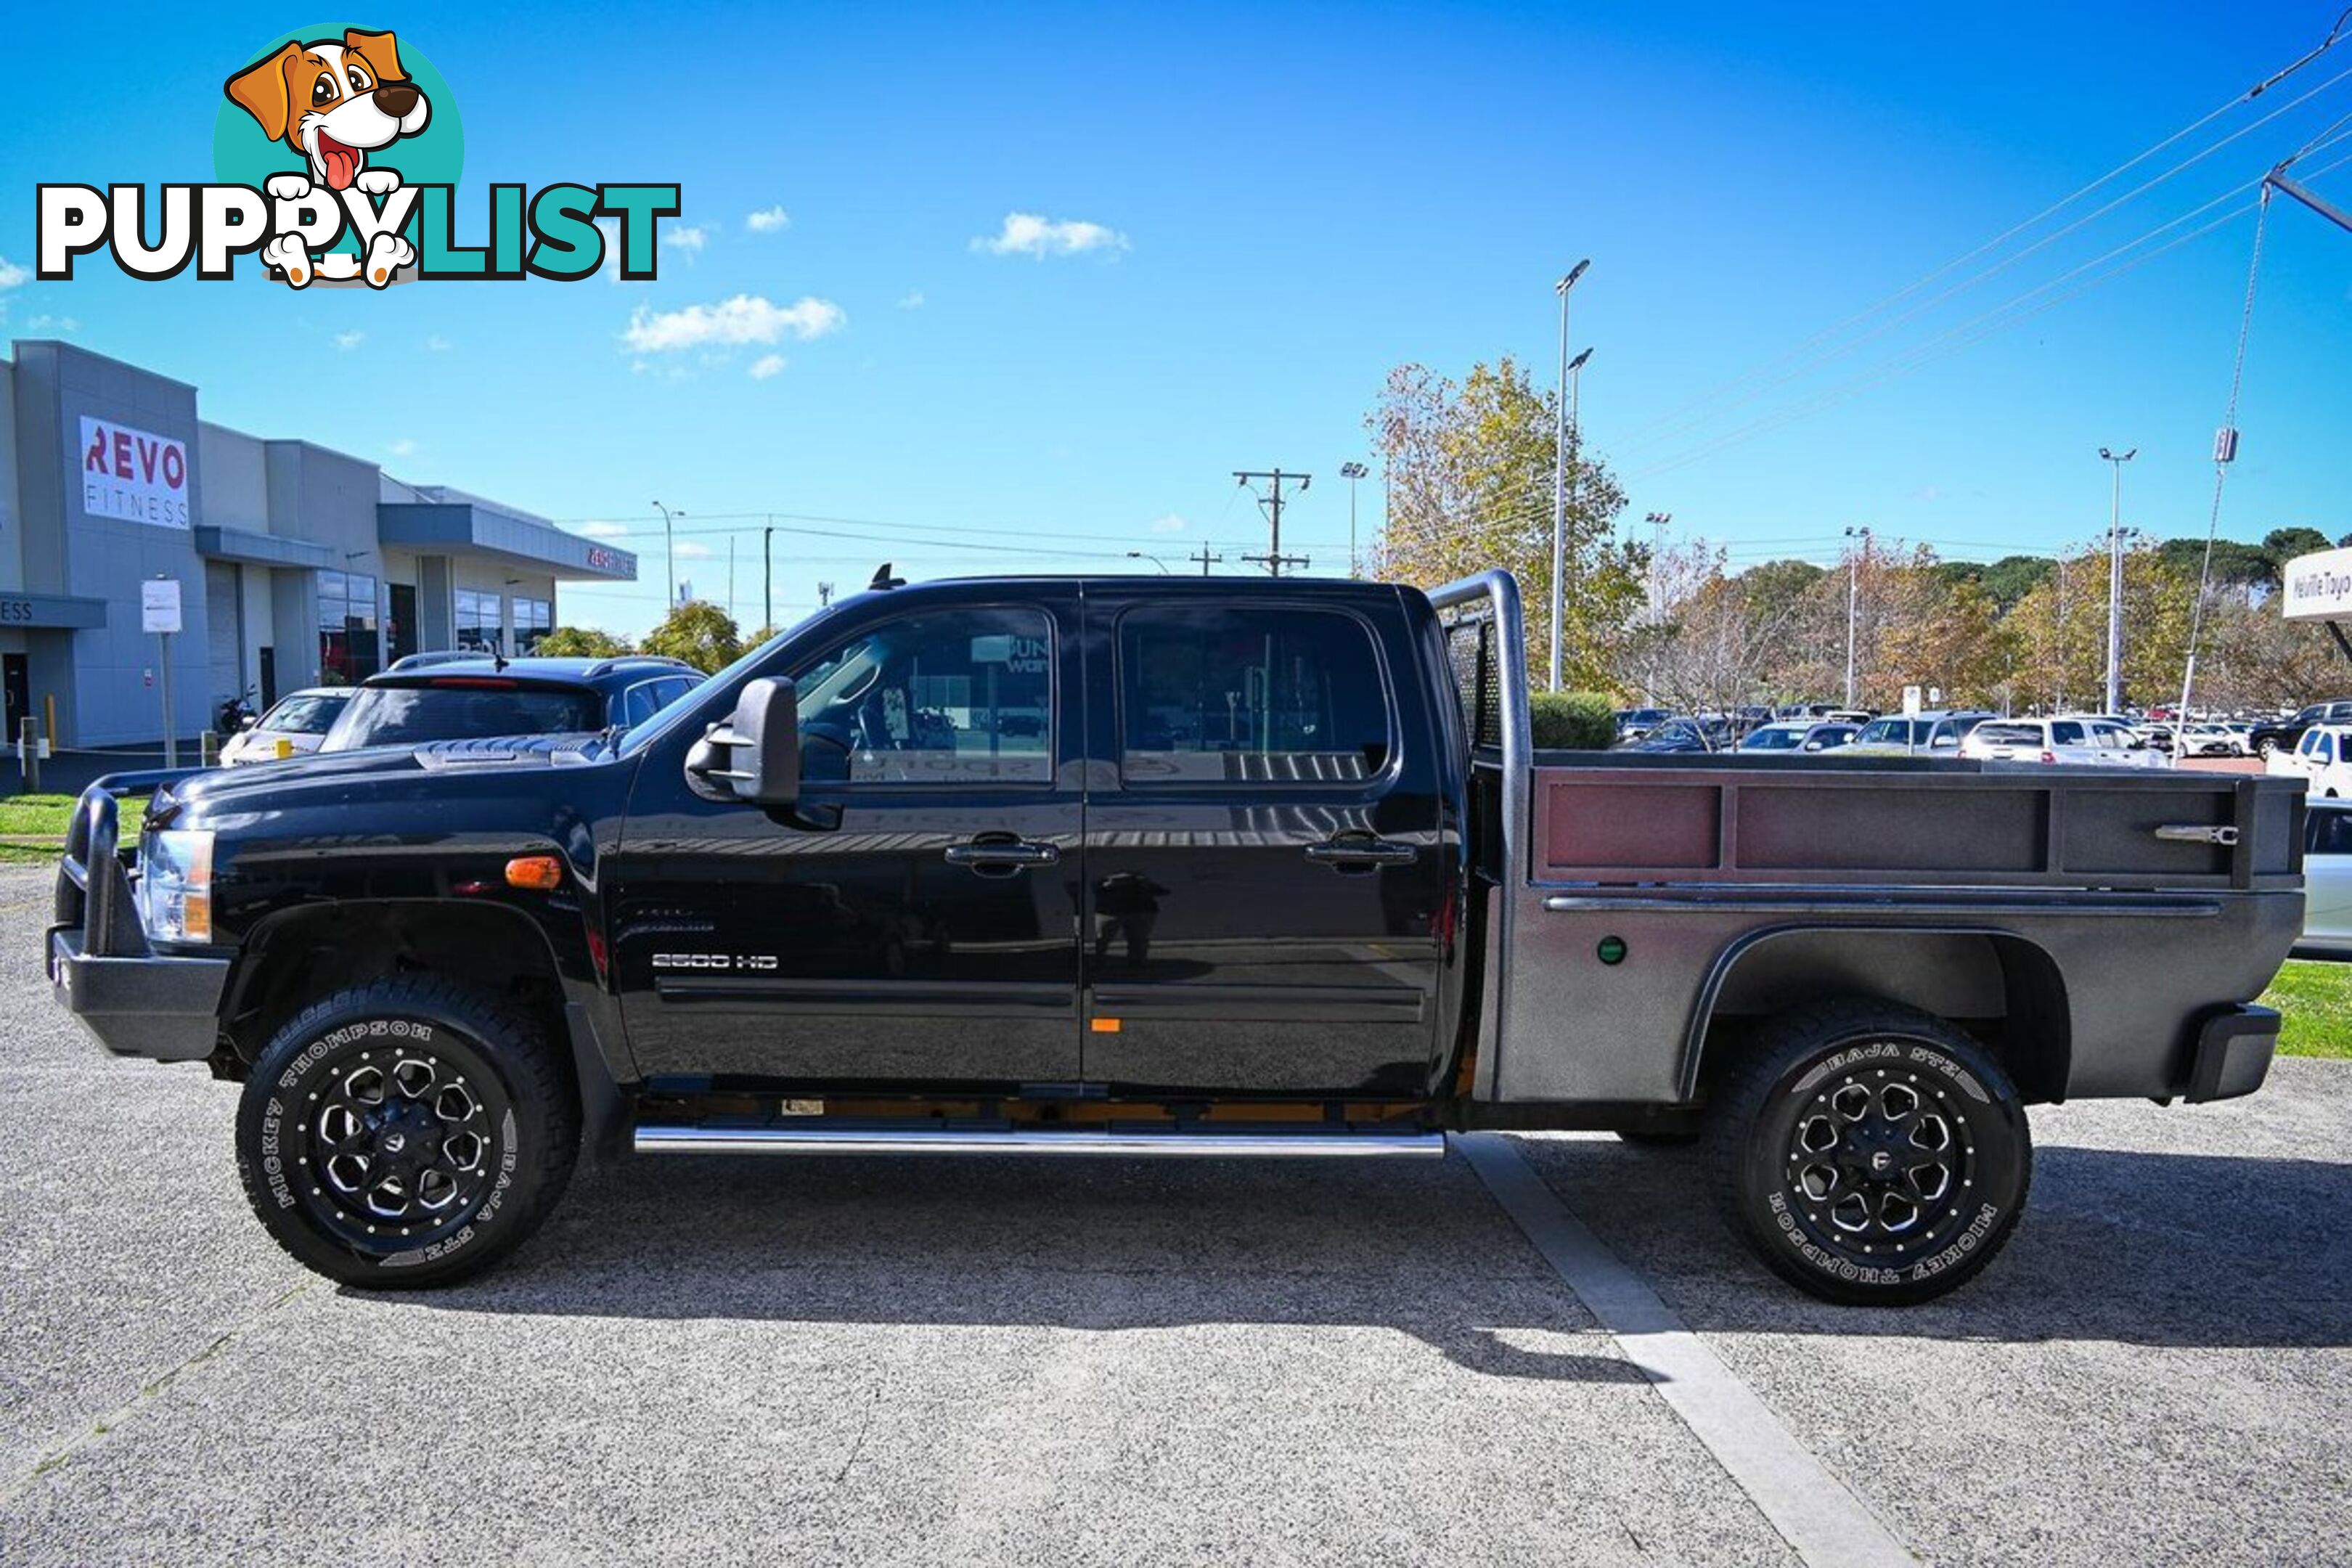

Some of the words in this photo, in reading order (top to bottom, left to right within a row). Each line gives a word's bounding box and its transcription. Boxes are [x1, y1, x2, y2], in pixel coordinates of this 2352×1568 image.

[86, 425, 184, 489] REVO
[87, 485, 187, 526] FITNESS
[653, 954, 730, 968] 2500
[737, 955, 777, 969] HD
[278, 1020, 432, 1089] THOMPSON
[262, 1097, 295, 1209] MICKEY
[1768, 1191, 1900, 1284] THOMPSON
[1912, 1203, 1998, 1281] MICKEY
